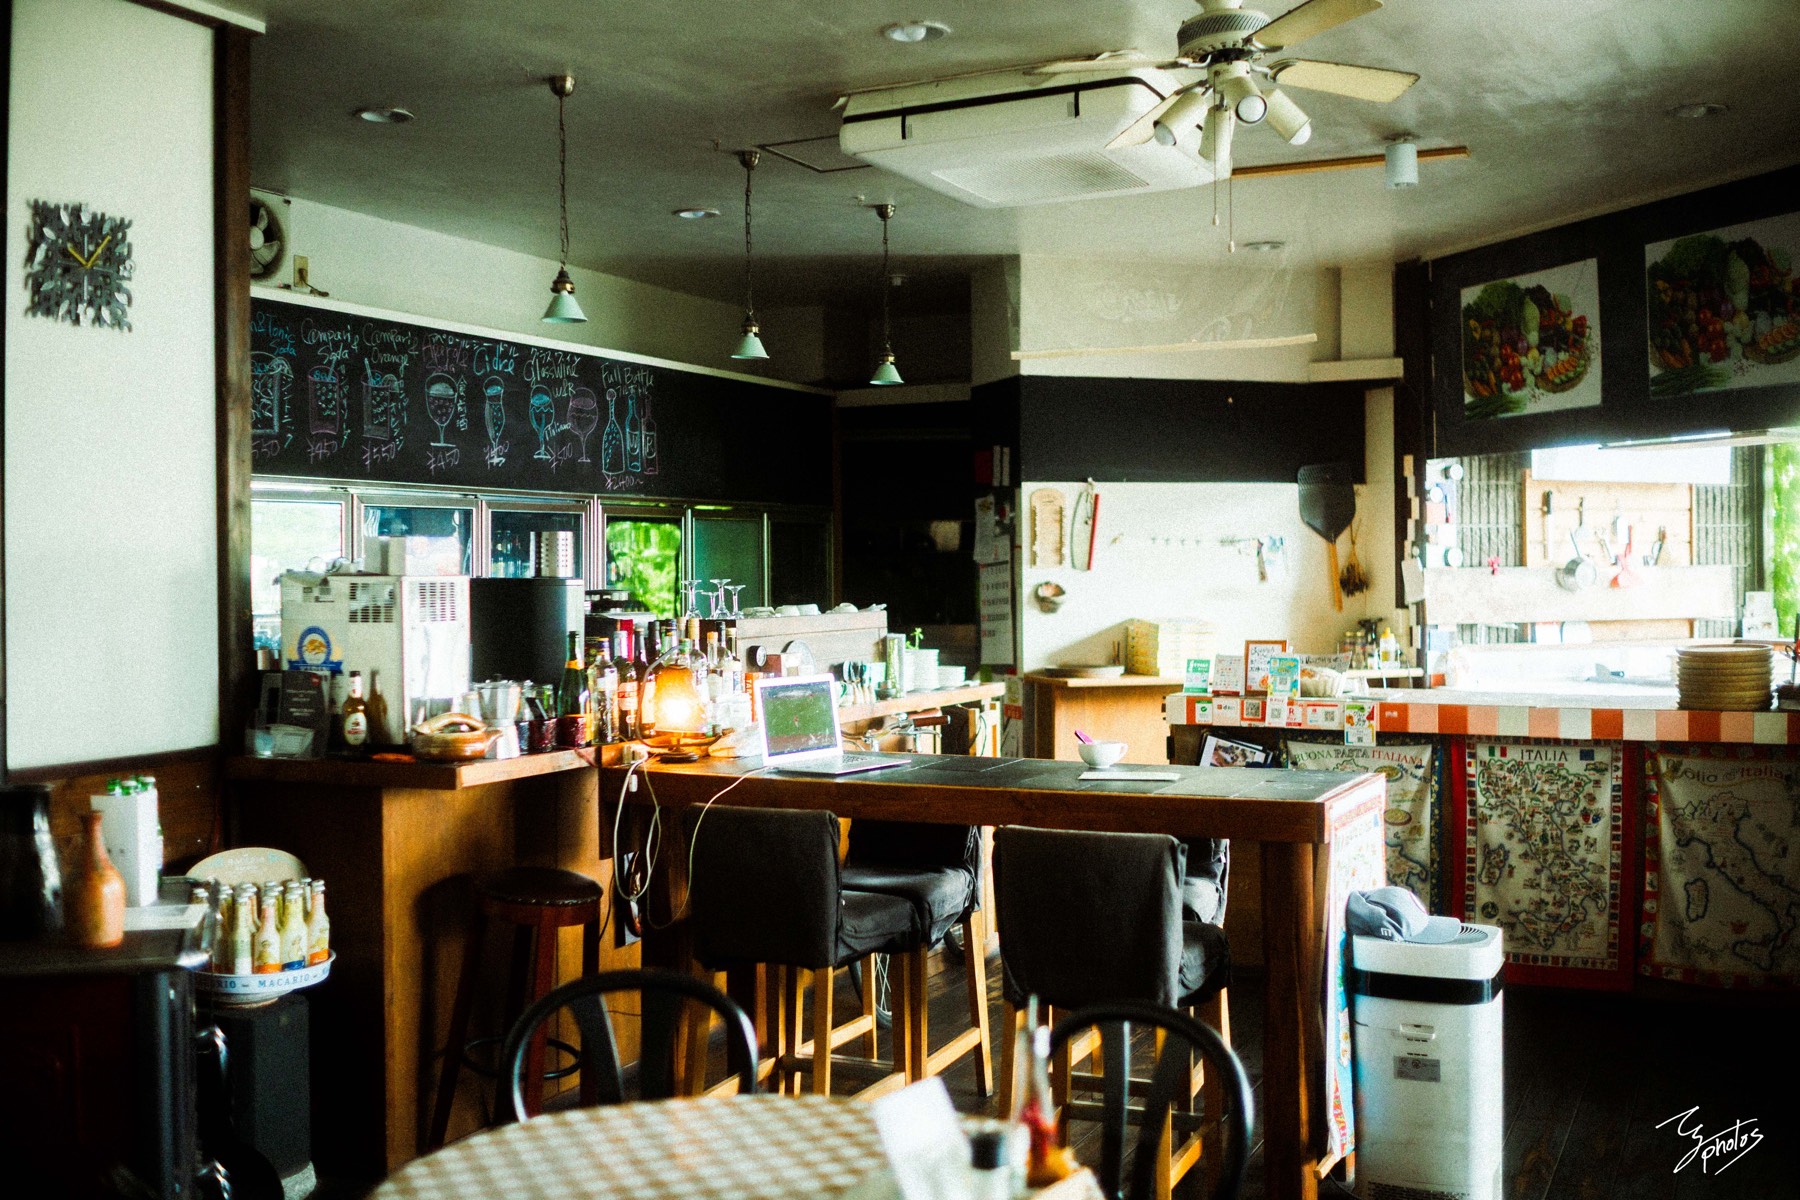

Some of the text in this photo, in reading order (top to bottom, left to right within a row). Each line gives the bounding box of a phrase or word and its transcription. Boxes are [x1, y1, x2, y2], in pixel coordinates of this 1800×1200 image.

[317, 342, 349, 364] Soda
[371, 347, 409, 378] Orange
[473, 344, 515, 376] Cidre
[600, 362, 654, 389] Full Bottle
[1294, 748, 1424, 766] BUONA PASTA ITALIANA
[1520, 749, 1568, 762] ITALIA
[257, 973, 310, 989] MACARIO
